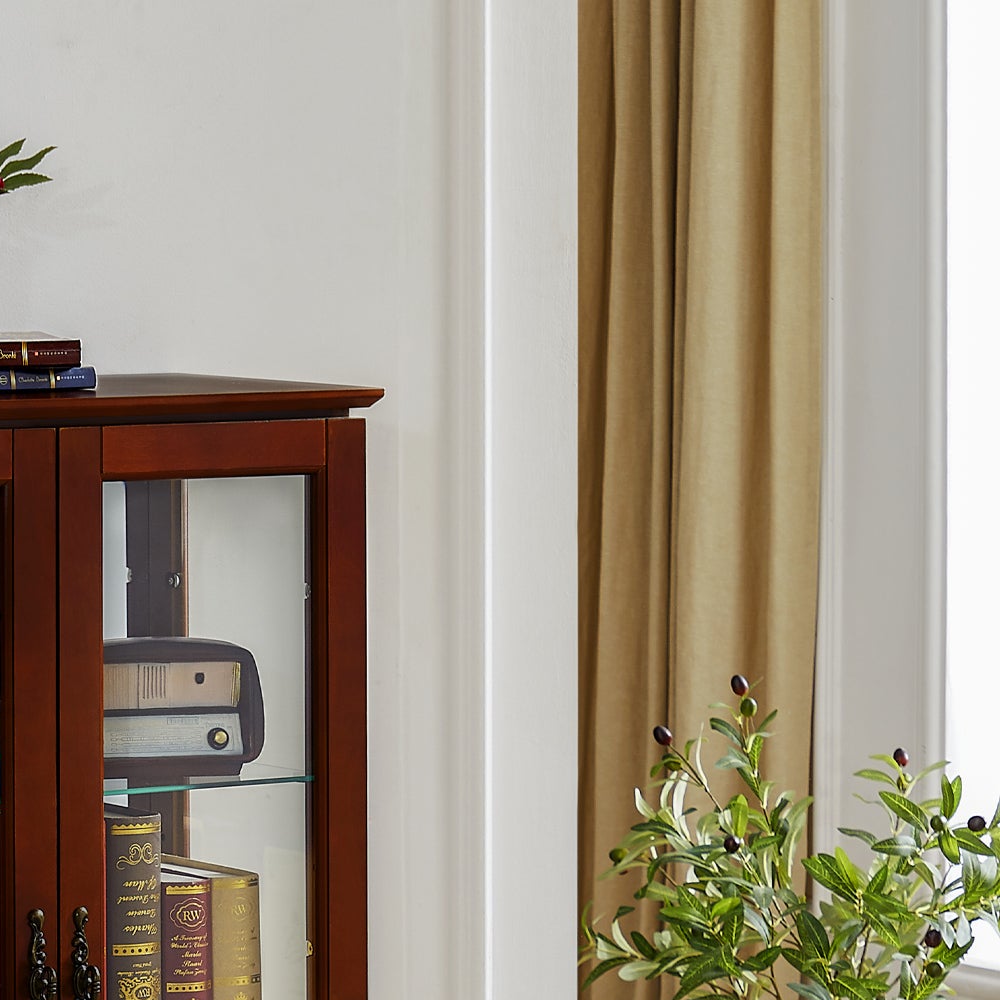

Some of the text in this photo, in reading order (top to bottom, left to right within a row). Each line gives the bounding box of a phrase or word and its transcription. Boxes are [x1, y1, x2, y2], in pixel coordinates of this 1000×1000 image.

[117, 895, 149, 904] Descent
[126, 908, 157, 918] Darwin
[183, 910, 202, 921] RW
[123, 923, 158, 935] Charles
